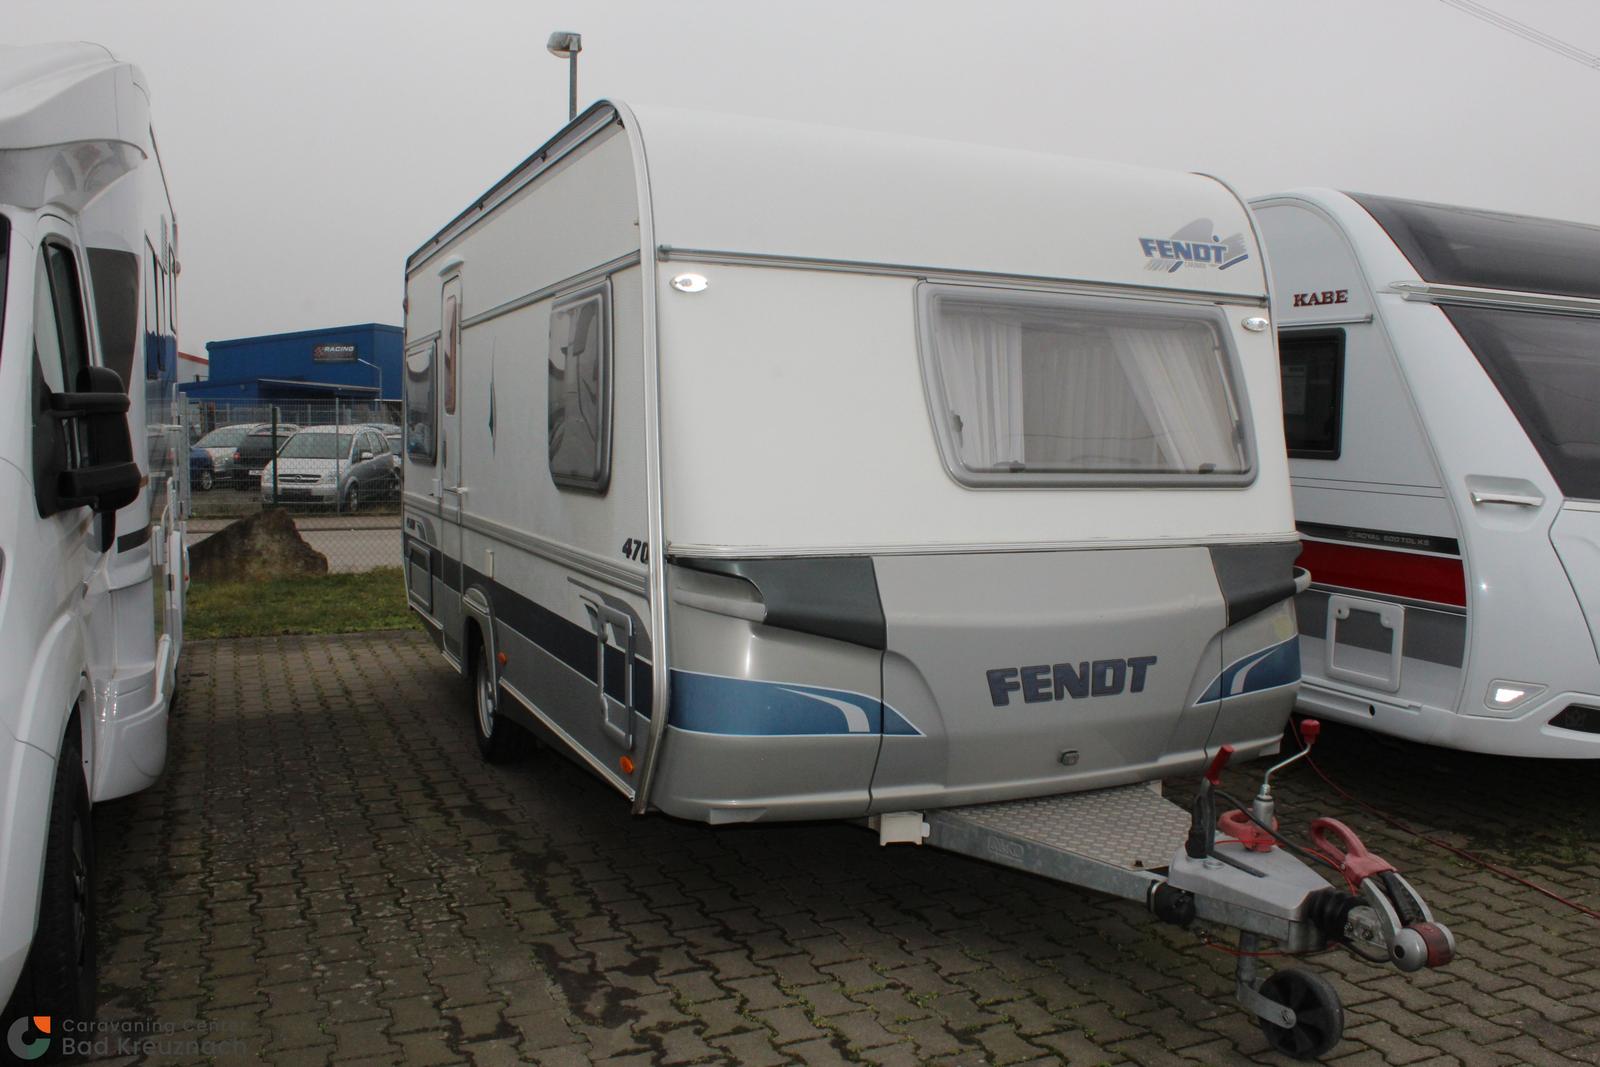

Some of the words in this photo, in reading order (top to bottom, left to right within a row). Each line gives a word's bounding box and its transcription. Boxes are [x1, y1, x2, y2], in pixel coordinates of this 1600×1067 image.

[1138, 237, 1227, 265] FENDT
[1293, 289, 1348, 307] KABE
[621, 537, 649, 565] 470
[986, 655, 1158, 707] FENDT
